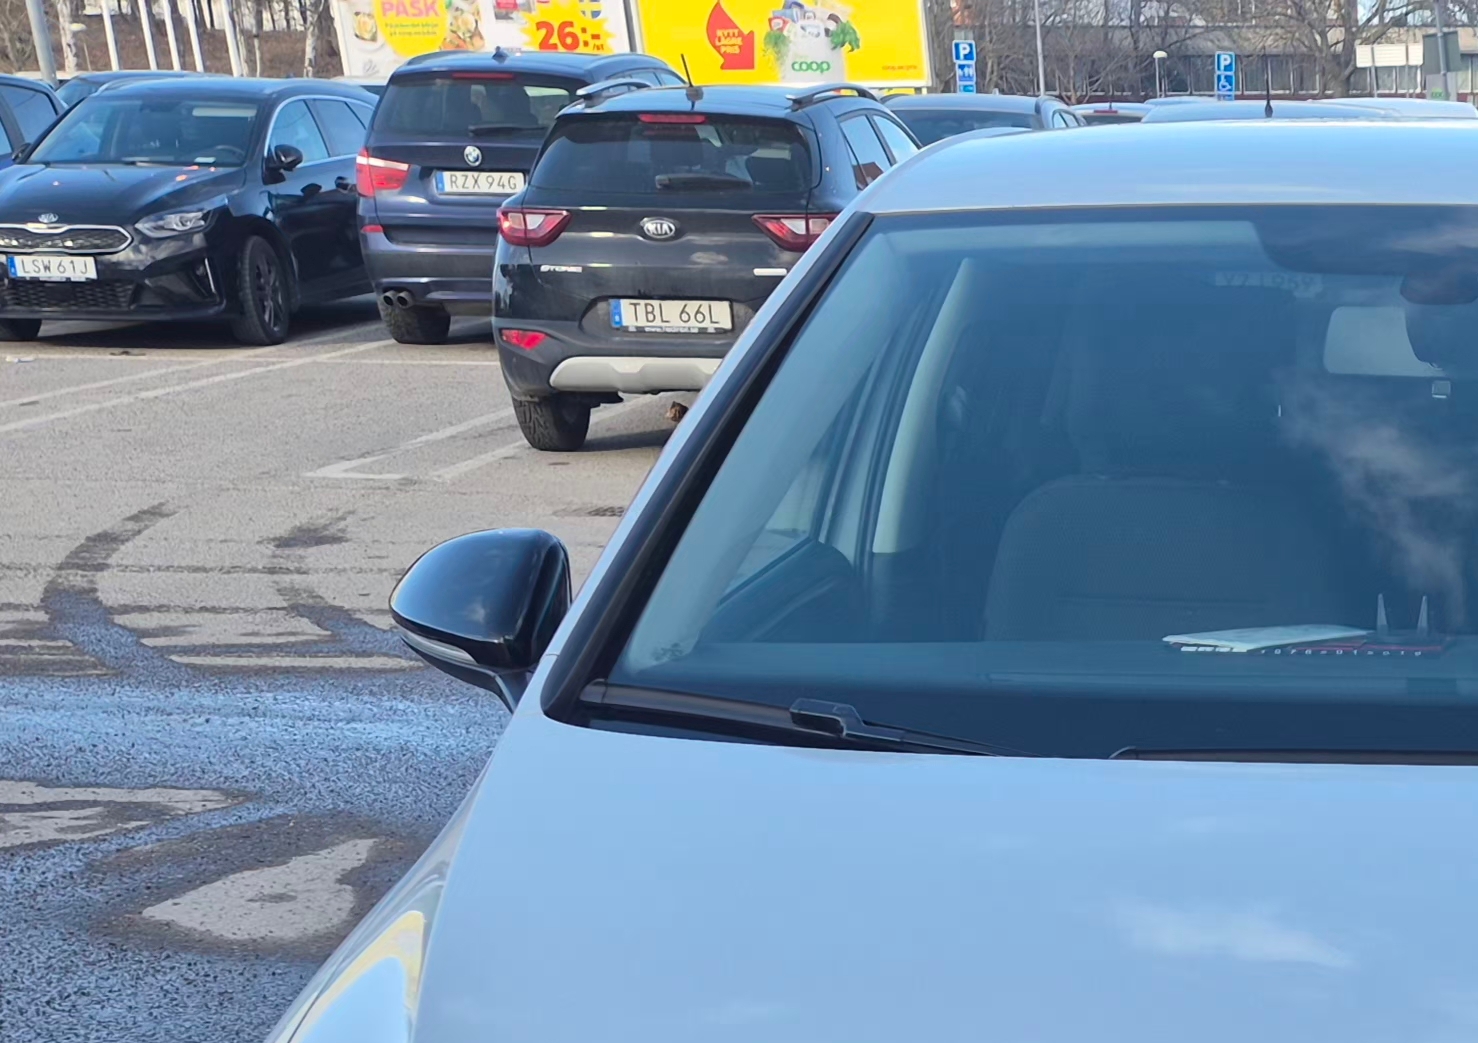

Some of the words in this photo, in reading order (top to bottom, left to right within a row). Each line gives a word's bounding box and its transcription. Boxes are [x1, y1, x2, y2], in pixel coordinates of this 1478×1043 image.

[959, 43, 970, 60] P
[792, 61, 830, 73] coop
[1220, 54, 1231, 71] P
[450, 173, 480, 189] RZX
[485, 175, 517, 190] 94G
[646, 222, 672, 236] KIA
[21, 259, 51, 274] LSW
[57, 260, 88, 275] 61J
[629, 302, 670, 323] TBL
[679, 303, 720, 324] 66L
